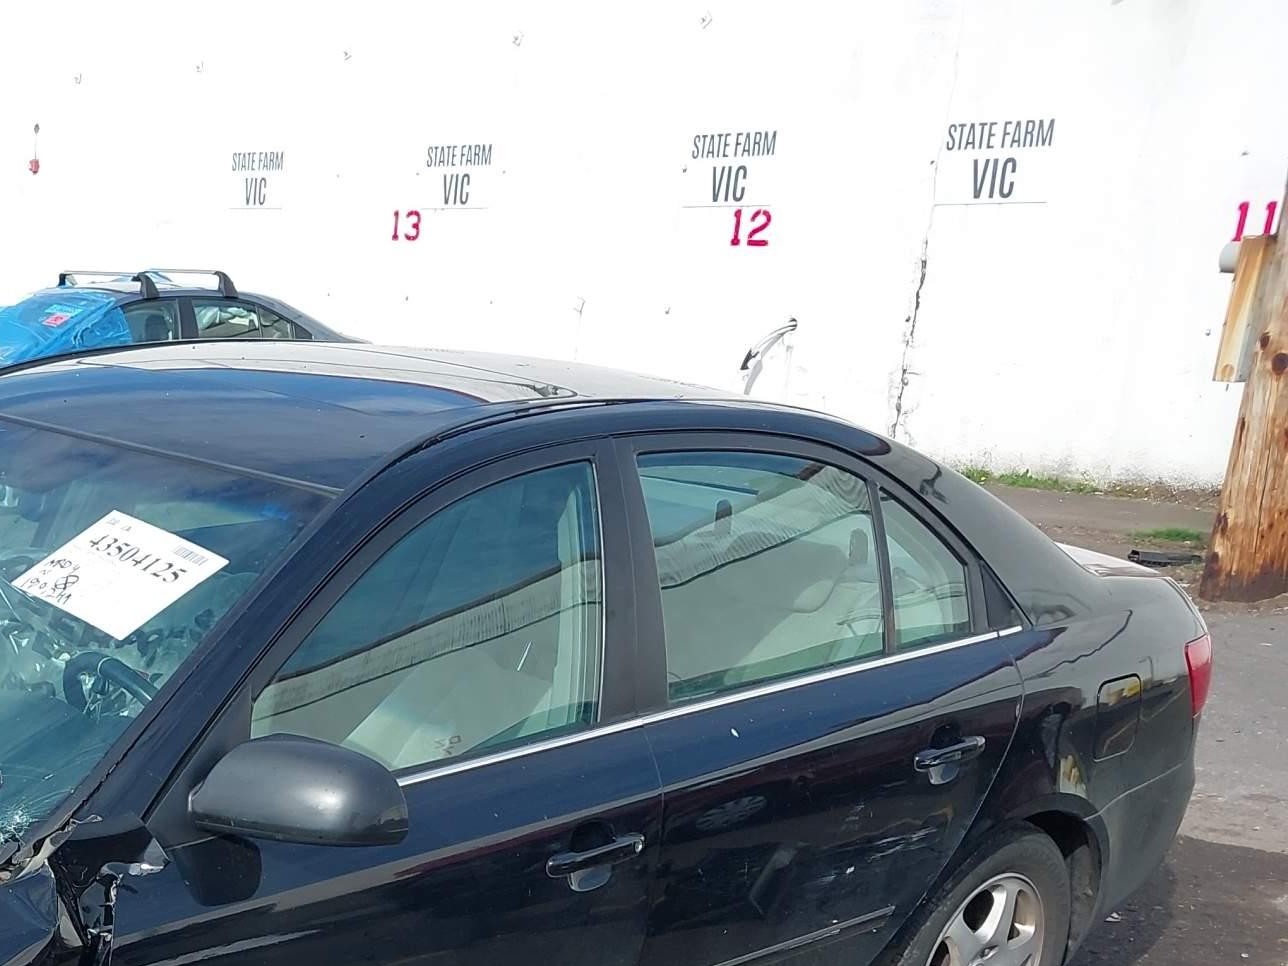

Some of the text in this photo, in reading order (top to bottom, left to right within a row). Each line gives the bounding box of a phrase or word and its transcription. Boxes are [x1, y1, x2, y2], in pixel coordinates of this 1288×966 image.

[691, 130, 777, 160] STATE FARM
[946, 118, 1056, 152] STATE FARM
[231, 151, 284, 172] STATE FARM
[426, 143, 493, 168] STATE FARM
[245, 177, 267, 206] VIC
[443, 172, 471, 206] VIC
[711, 164, 748, 203] VIC
[972, 157, 1017, 200] VIC
[391, 209, 421, 242] 13
[729, 208, 772, 248] 12
[89, 534, 188, 583] 43504125
